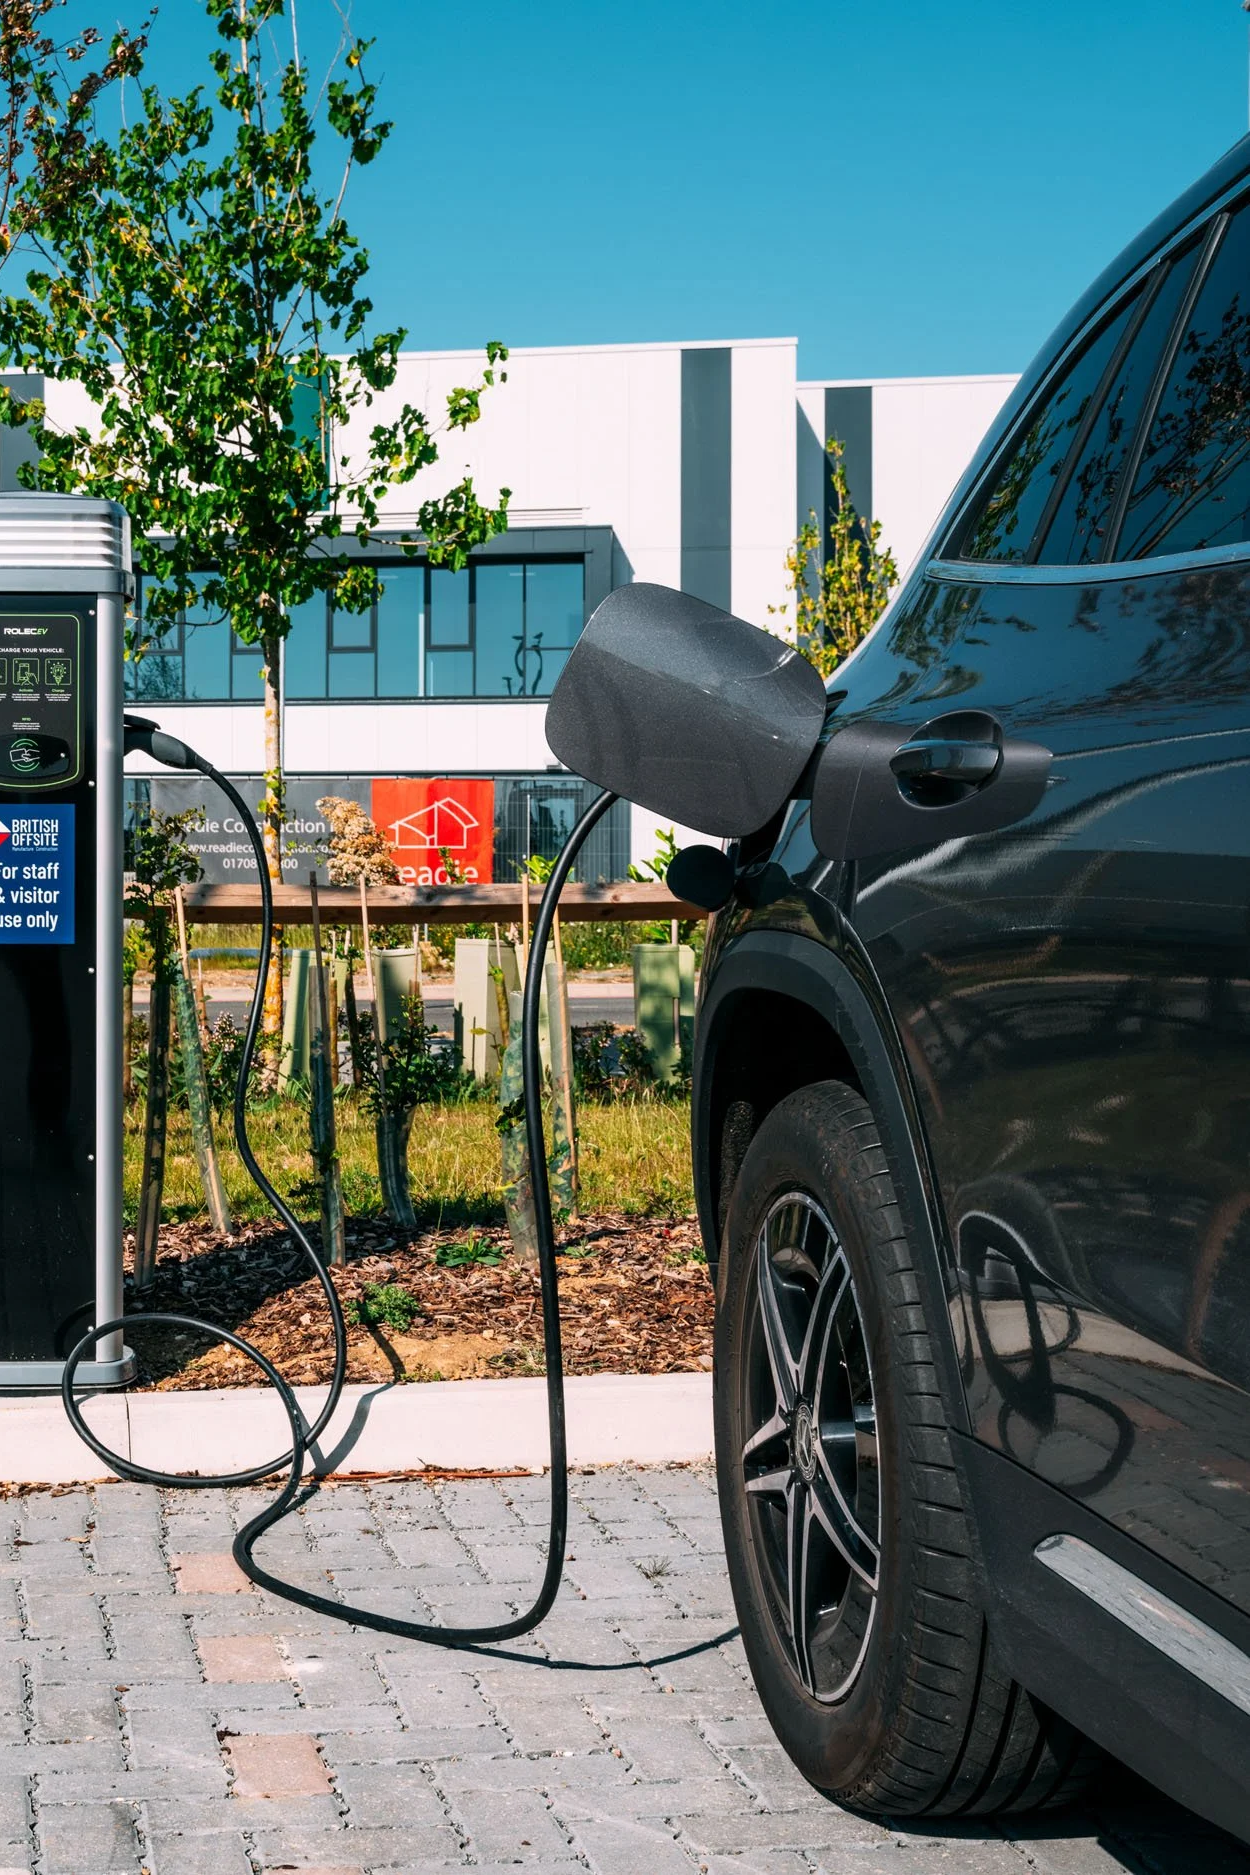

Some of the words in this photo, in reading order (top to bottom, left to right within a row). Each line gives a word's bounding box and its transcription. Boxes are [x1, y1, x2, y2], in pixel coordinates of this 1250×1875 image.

[11, 819, 59, 833] BRITISH
[11, 833, 59, 846] OFFSITE
[22, 862, 60, 879] staff
[397, 859, 479, 887] eadie
[10, 886, 60, 904] visitor
[26, 910, 58, 932] only
